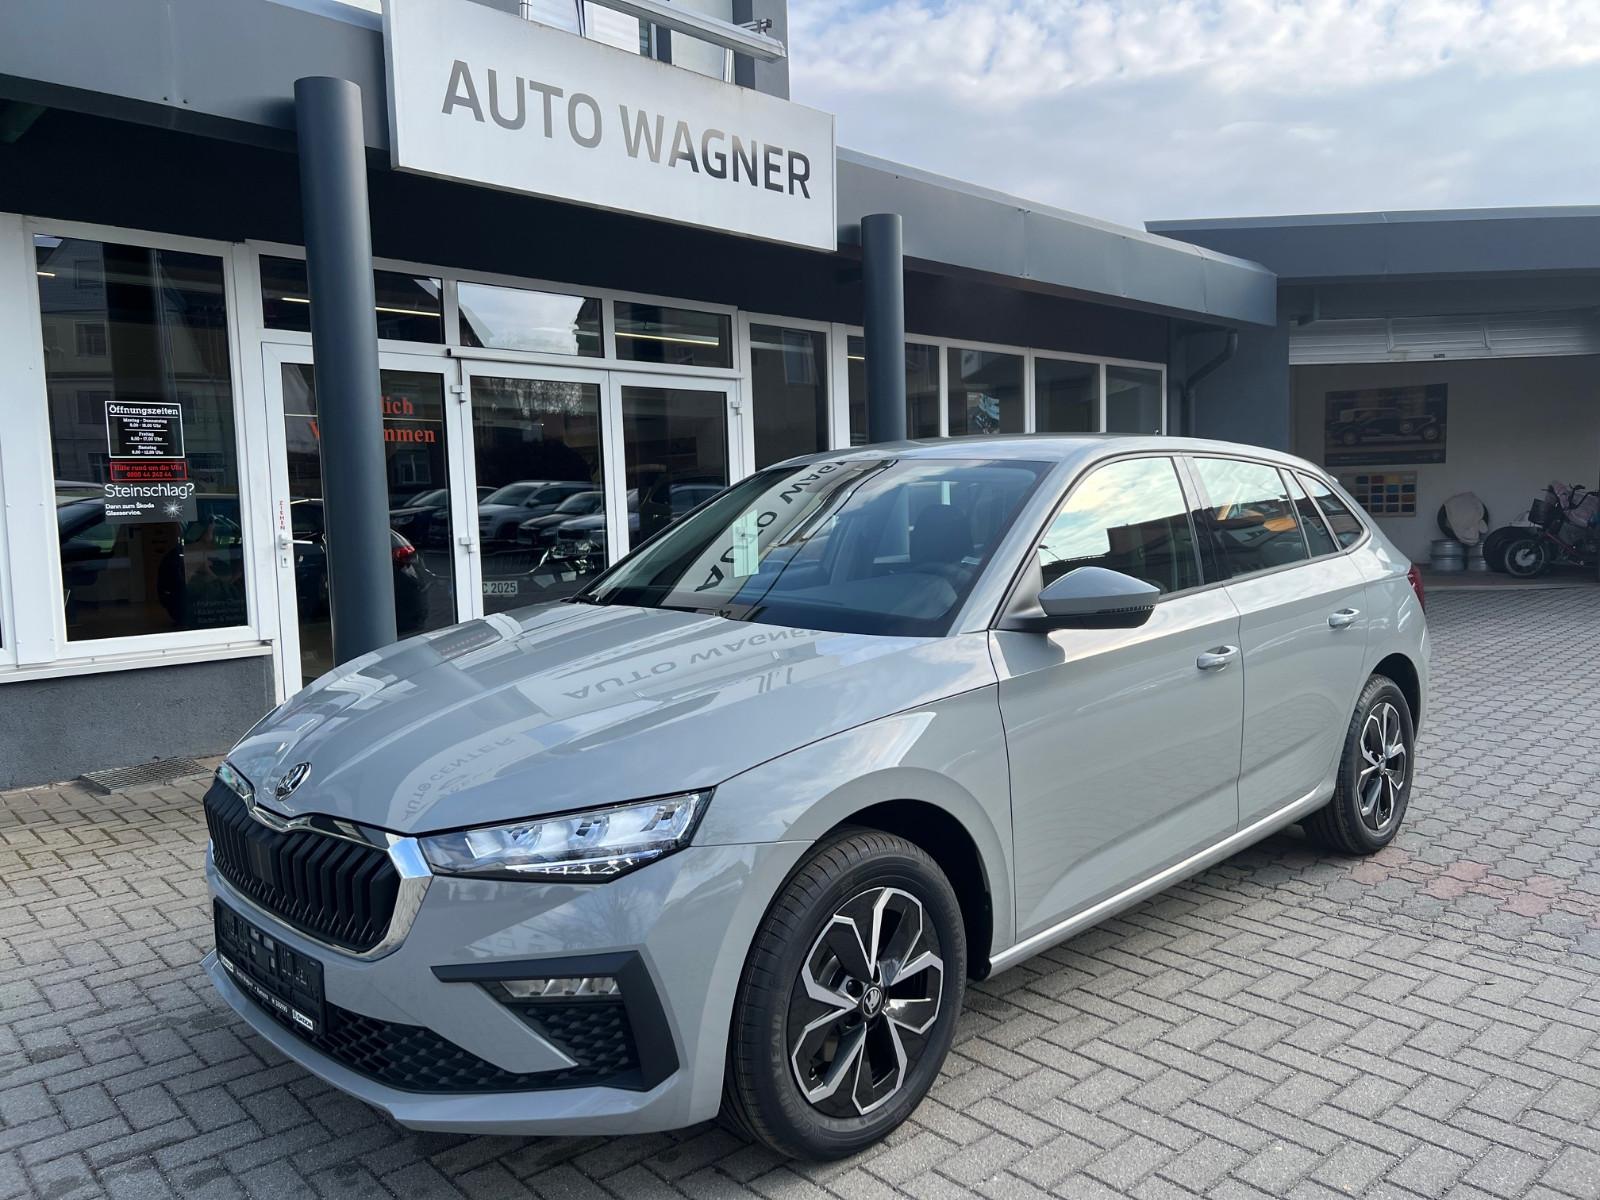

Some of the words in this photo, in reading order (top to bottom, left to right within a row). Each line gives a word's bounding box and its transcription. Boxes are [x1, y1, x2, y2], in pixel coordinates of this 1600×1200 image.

[442, 59, 602, 149] AUTO
[619, 104, 811, 199] WAGNER
[109, 404, 179, 416] Öffnungszeiten
[104, 482, 195, 499] Steinschlag?
[490, 582, 516, 594] 2025
